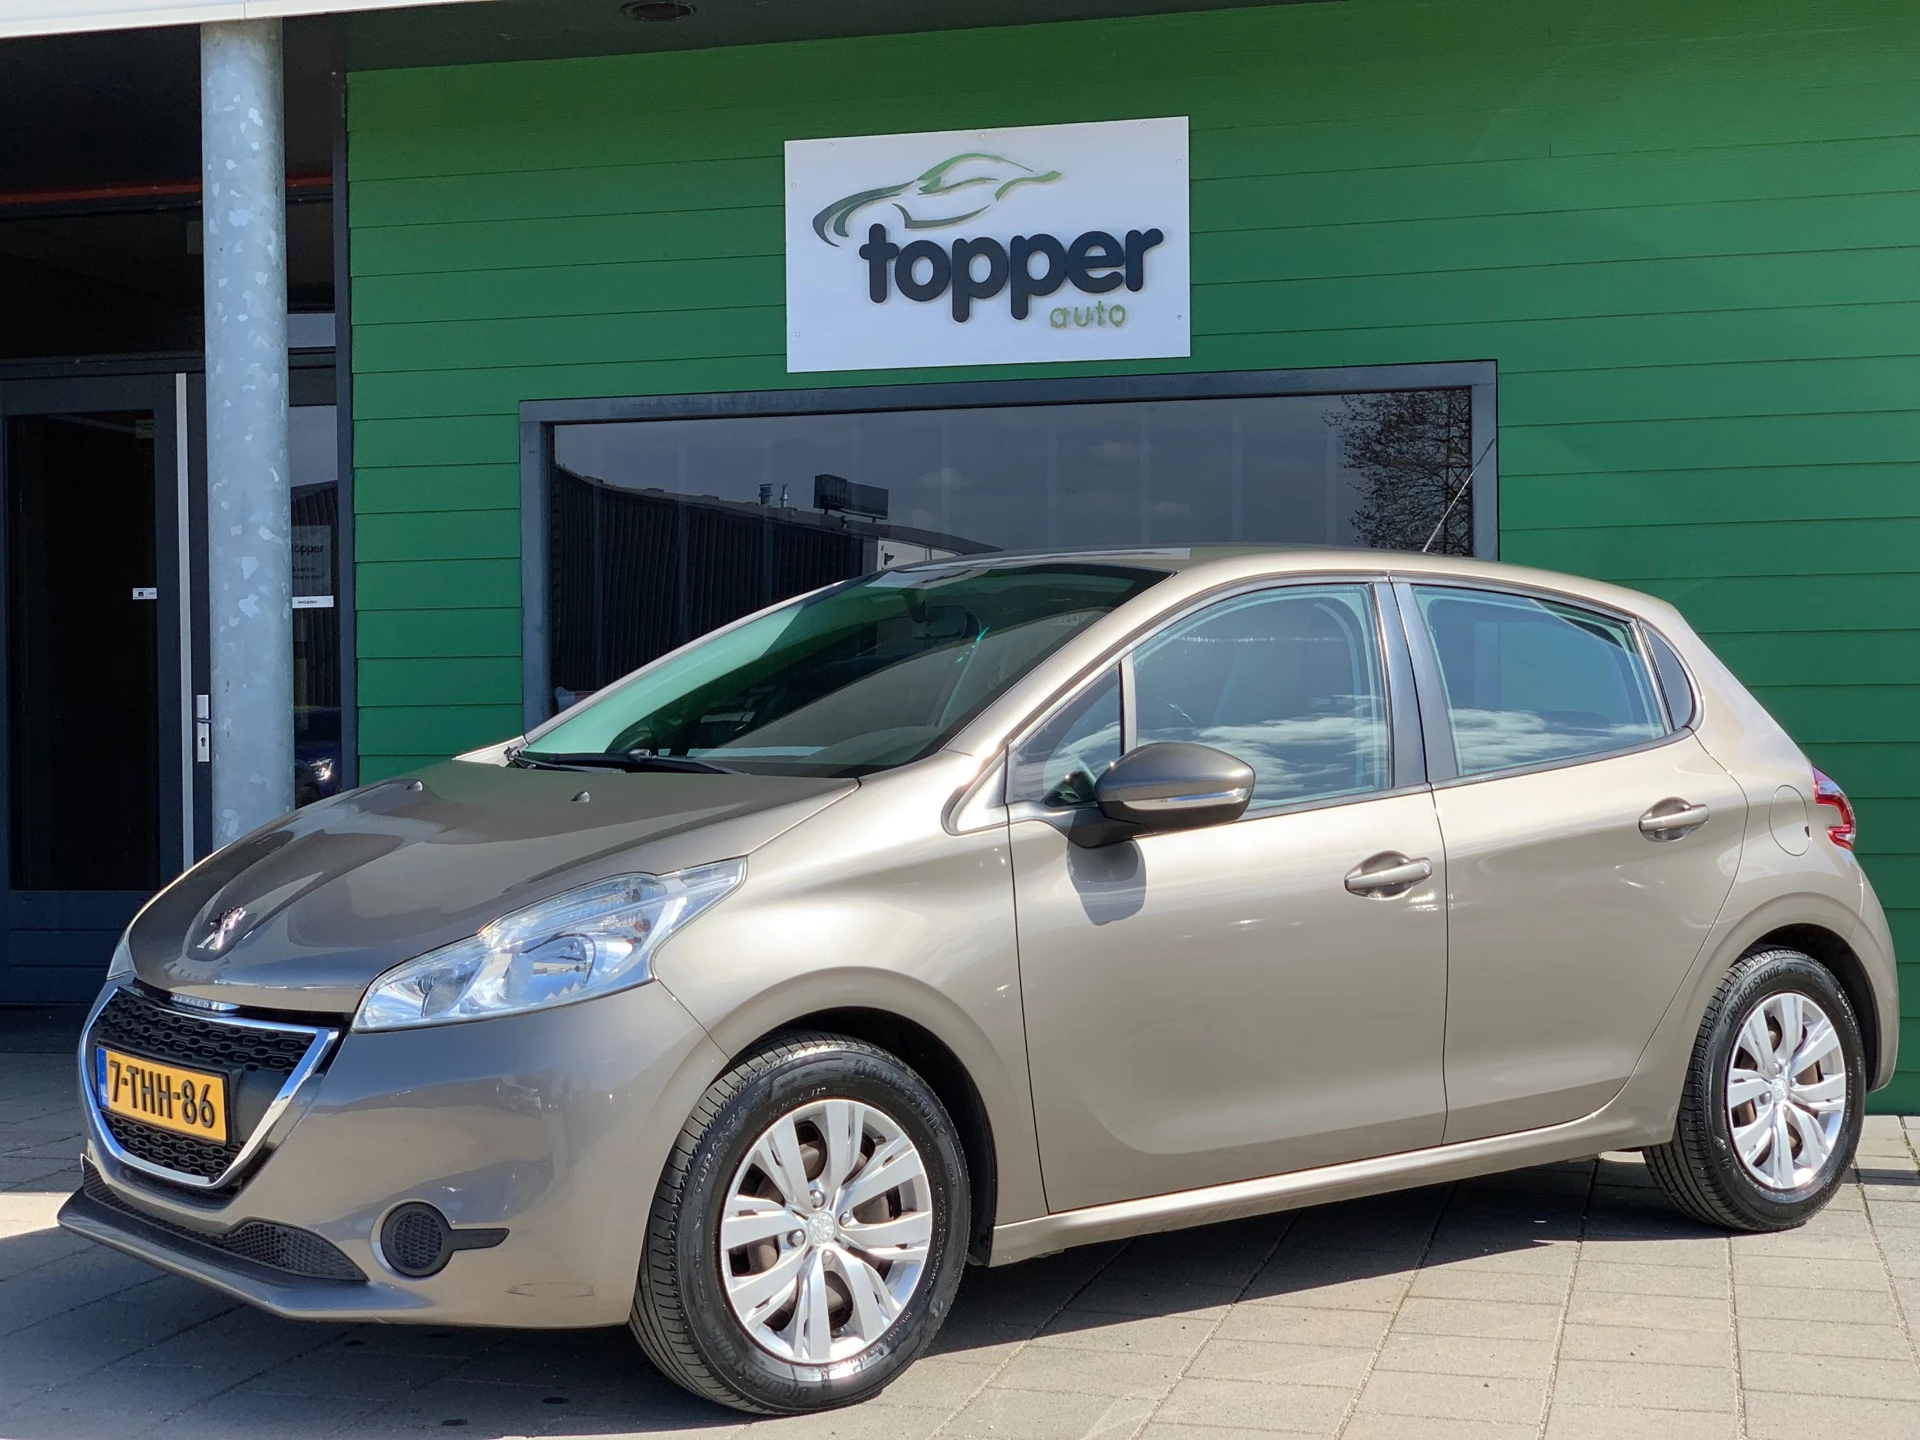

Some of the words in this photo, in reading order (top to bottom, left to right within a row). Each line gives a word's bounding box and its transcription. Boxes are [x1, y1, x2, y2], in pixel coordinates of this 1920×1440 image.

[859, 223, 1164, 323] topper
[1050, 301, 1126, 328] auto
[109, 1060, 215, 1129] 7-THH-86
